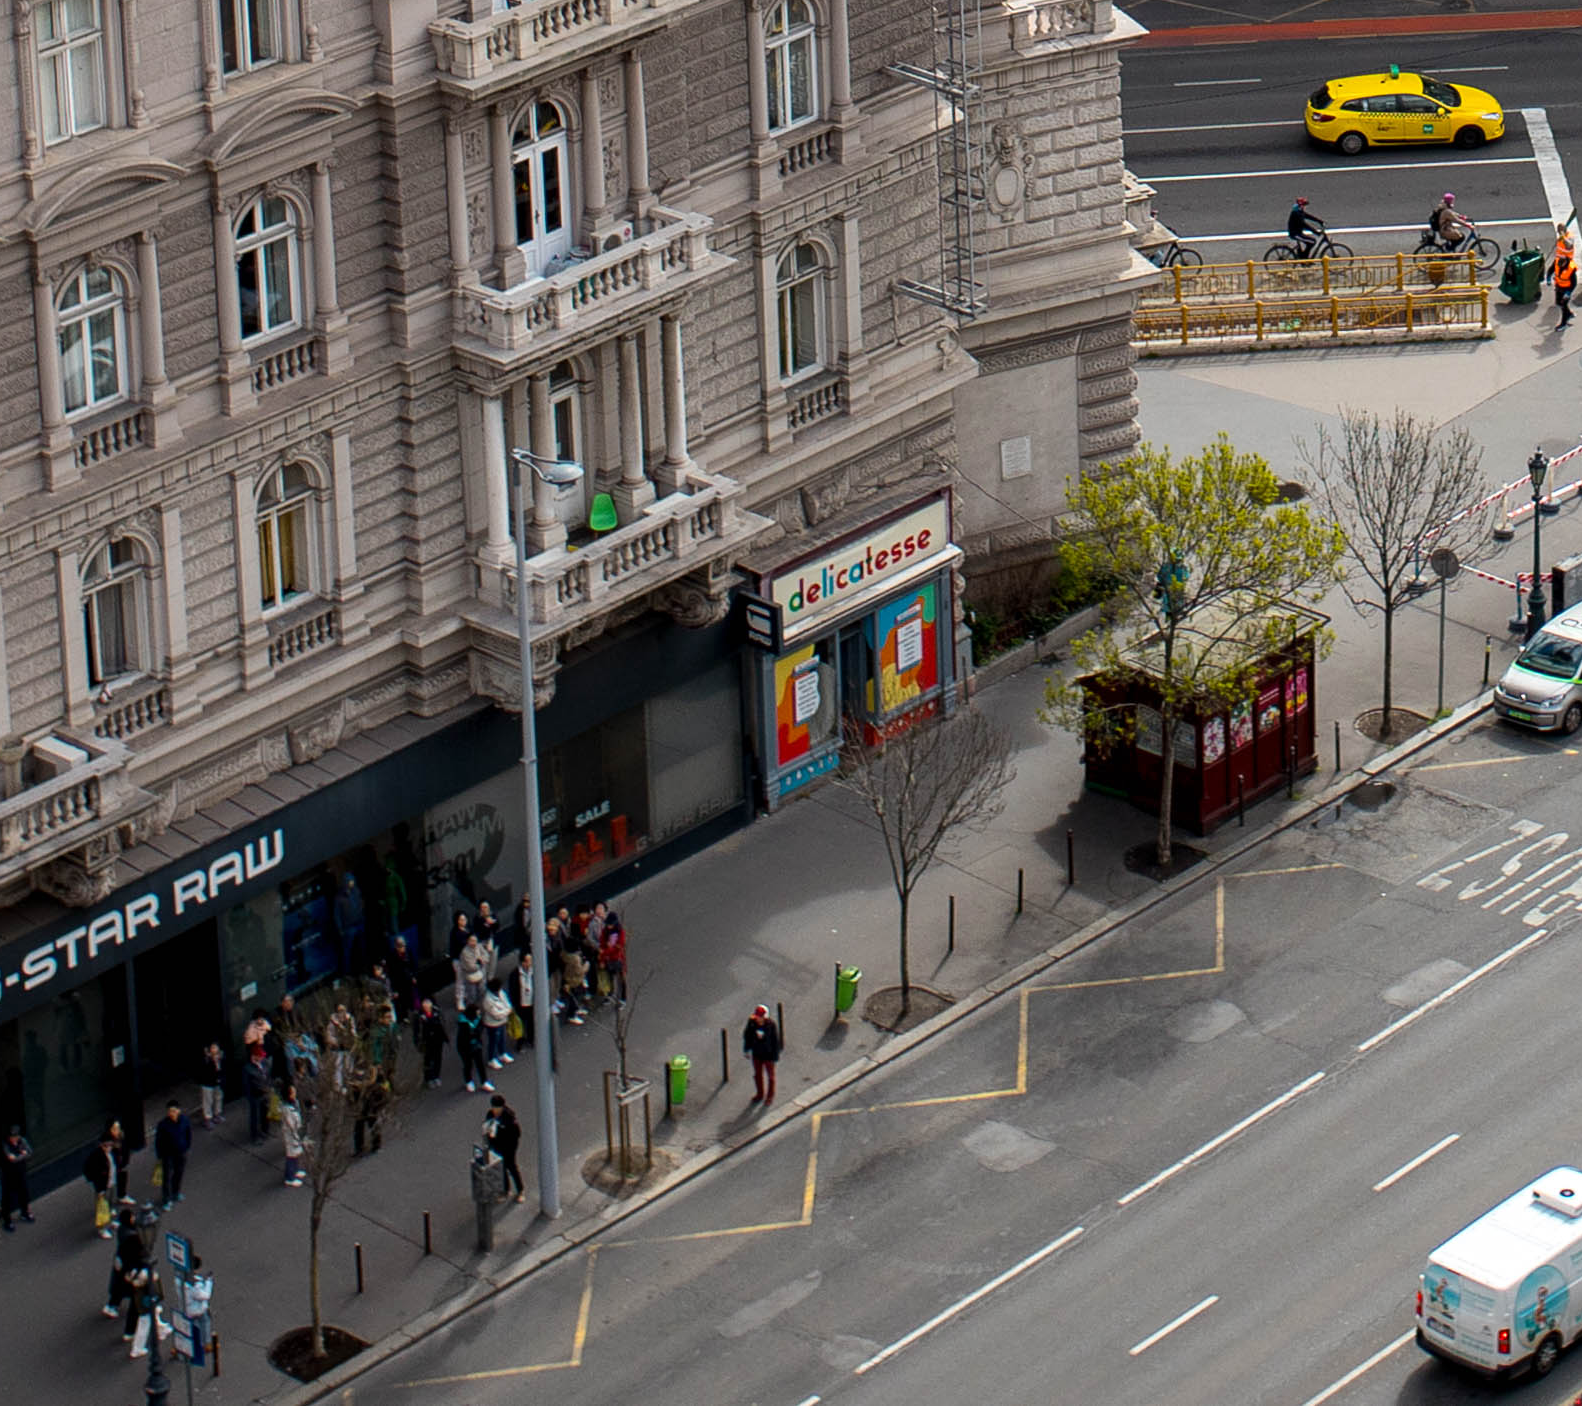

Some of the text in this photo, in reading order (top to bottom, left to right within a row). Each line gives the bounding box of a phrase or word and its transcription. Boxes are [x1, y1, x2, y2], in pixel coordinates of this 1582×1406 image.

[788, 529, 931, 612] delicatesse
[575, 800, 610, 828] SALE
[173, 829, 284, 915] RAW
